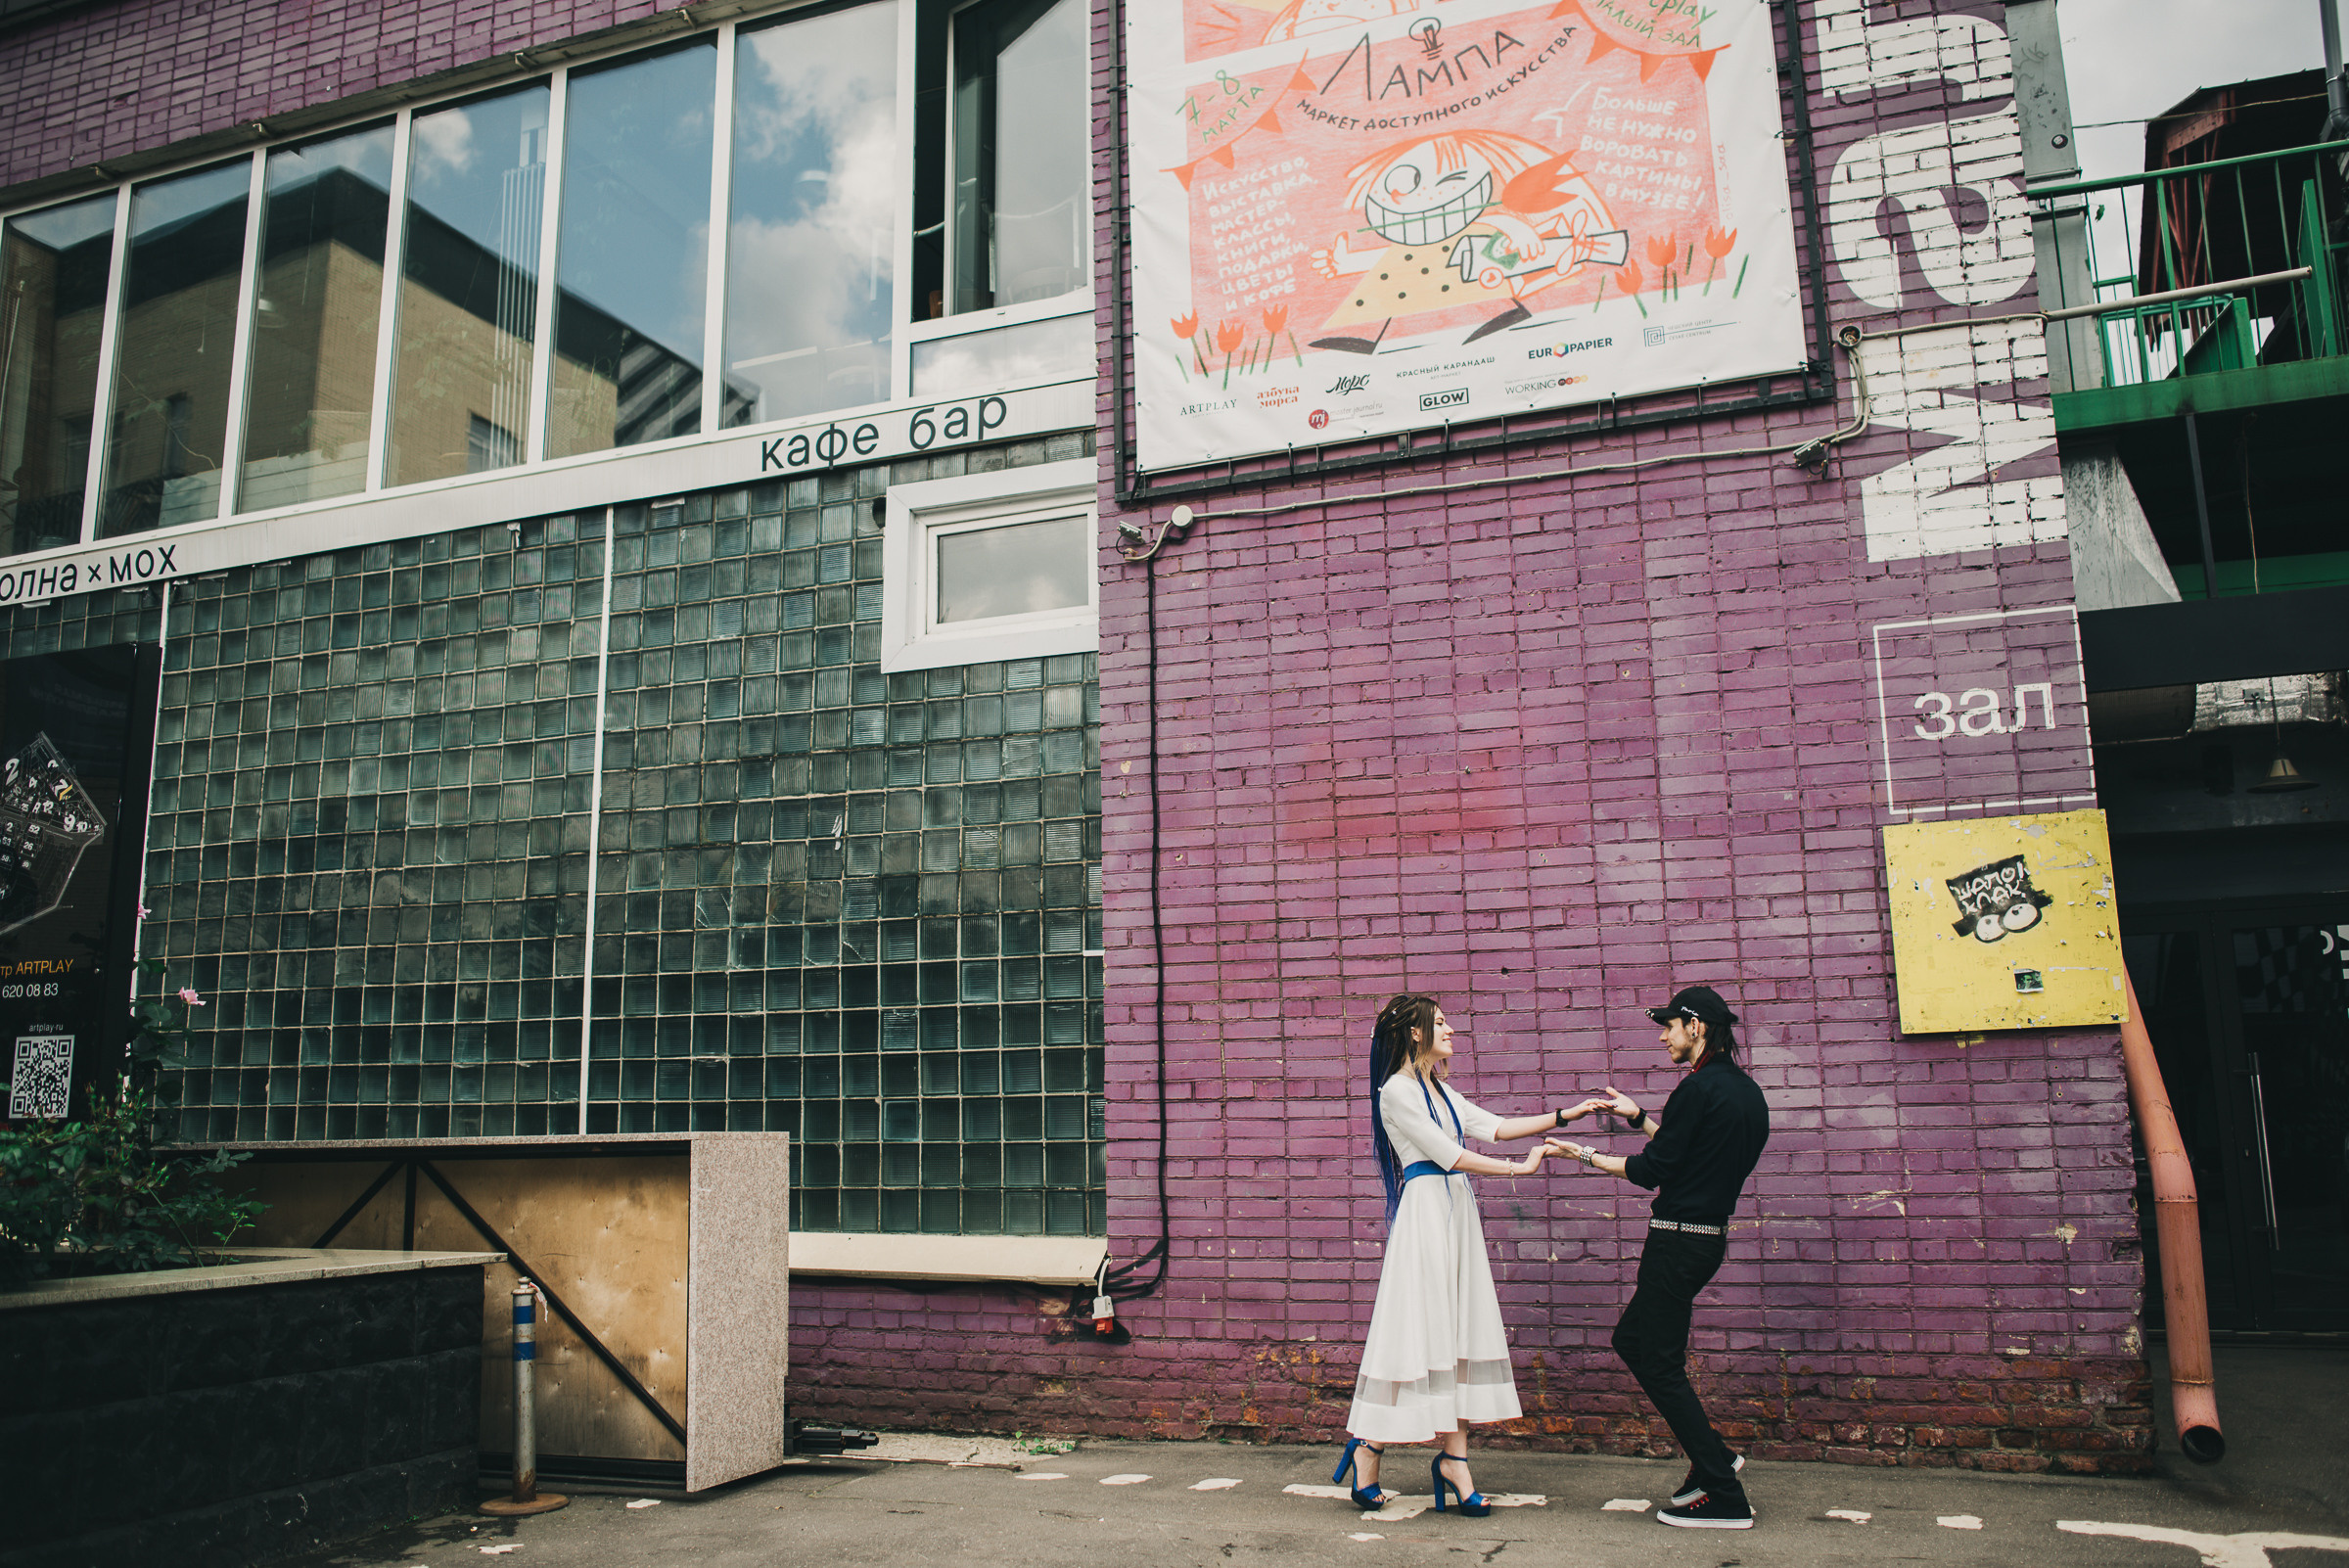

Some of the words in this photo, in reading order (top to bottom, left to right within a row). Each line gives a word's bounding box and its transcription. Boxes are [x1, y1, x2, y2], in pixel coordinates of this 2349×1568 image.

[1596, 0, 1655, 39] АЛЫЙ
[1659, 29, 1700, 48] ЗАЛ
[1649, 0, 1718, 29] play
[1297, 100, 1359, 130] МАРКЕТ
[1363, 96, 1481, 131] ДОСТУПНОГО
[1485, 26, 1578, 100] ИСКУССТВА
[1202, 86, 1265, 144] МАРТА
[1588, 115, 1617, 131] НЕ
[1621, 118, 1697, 144] НУЖНО
[1580, 133, 1687, 167] ВОРОВАТЬ
[1594, 160, 1702, 192] КАРТИНЫ
[1605, 182, 1617, 198] В
[1221, 263, 1294, 295] ЦВЕТЫ
[1243, 277, 1297, 306] КОФЕ
[1397, 364, 1440, 379] КРАСНЫЙ
[1444, 356, 1496, 370] КАРАНДАШ
[1257, 386, 1300, 400] азбука
[1423, 392, 1464, 407] GLOW
[1504, 379, 1557, 394] WORKING
[1179, 398, 1238, 416] ARTPLAY
[1259, 395, 1298, 409] морса
[761, 422, 879, 471] кафе
[909, 396, 1007, 450] бар
[110, 544, 177, 583] мох
[1913, 681, 2055, 741] зал
[16, 958, 73, 975] ARTPLAY
[2, 985, 23, 998] 620
[26, 984, 41, 997] 08
[44, 983, 59, 996] 83
